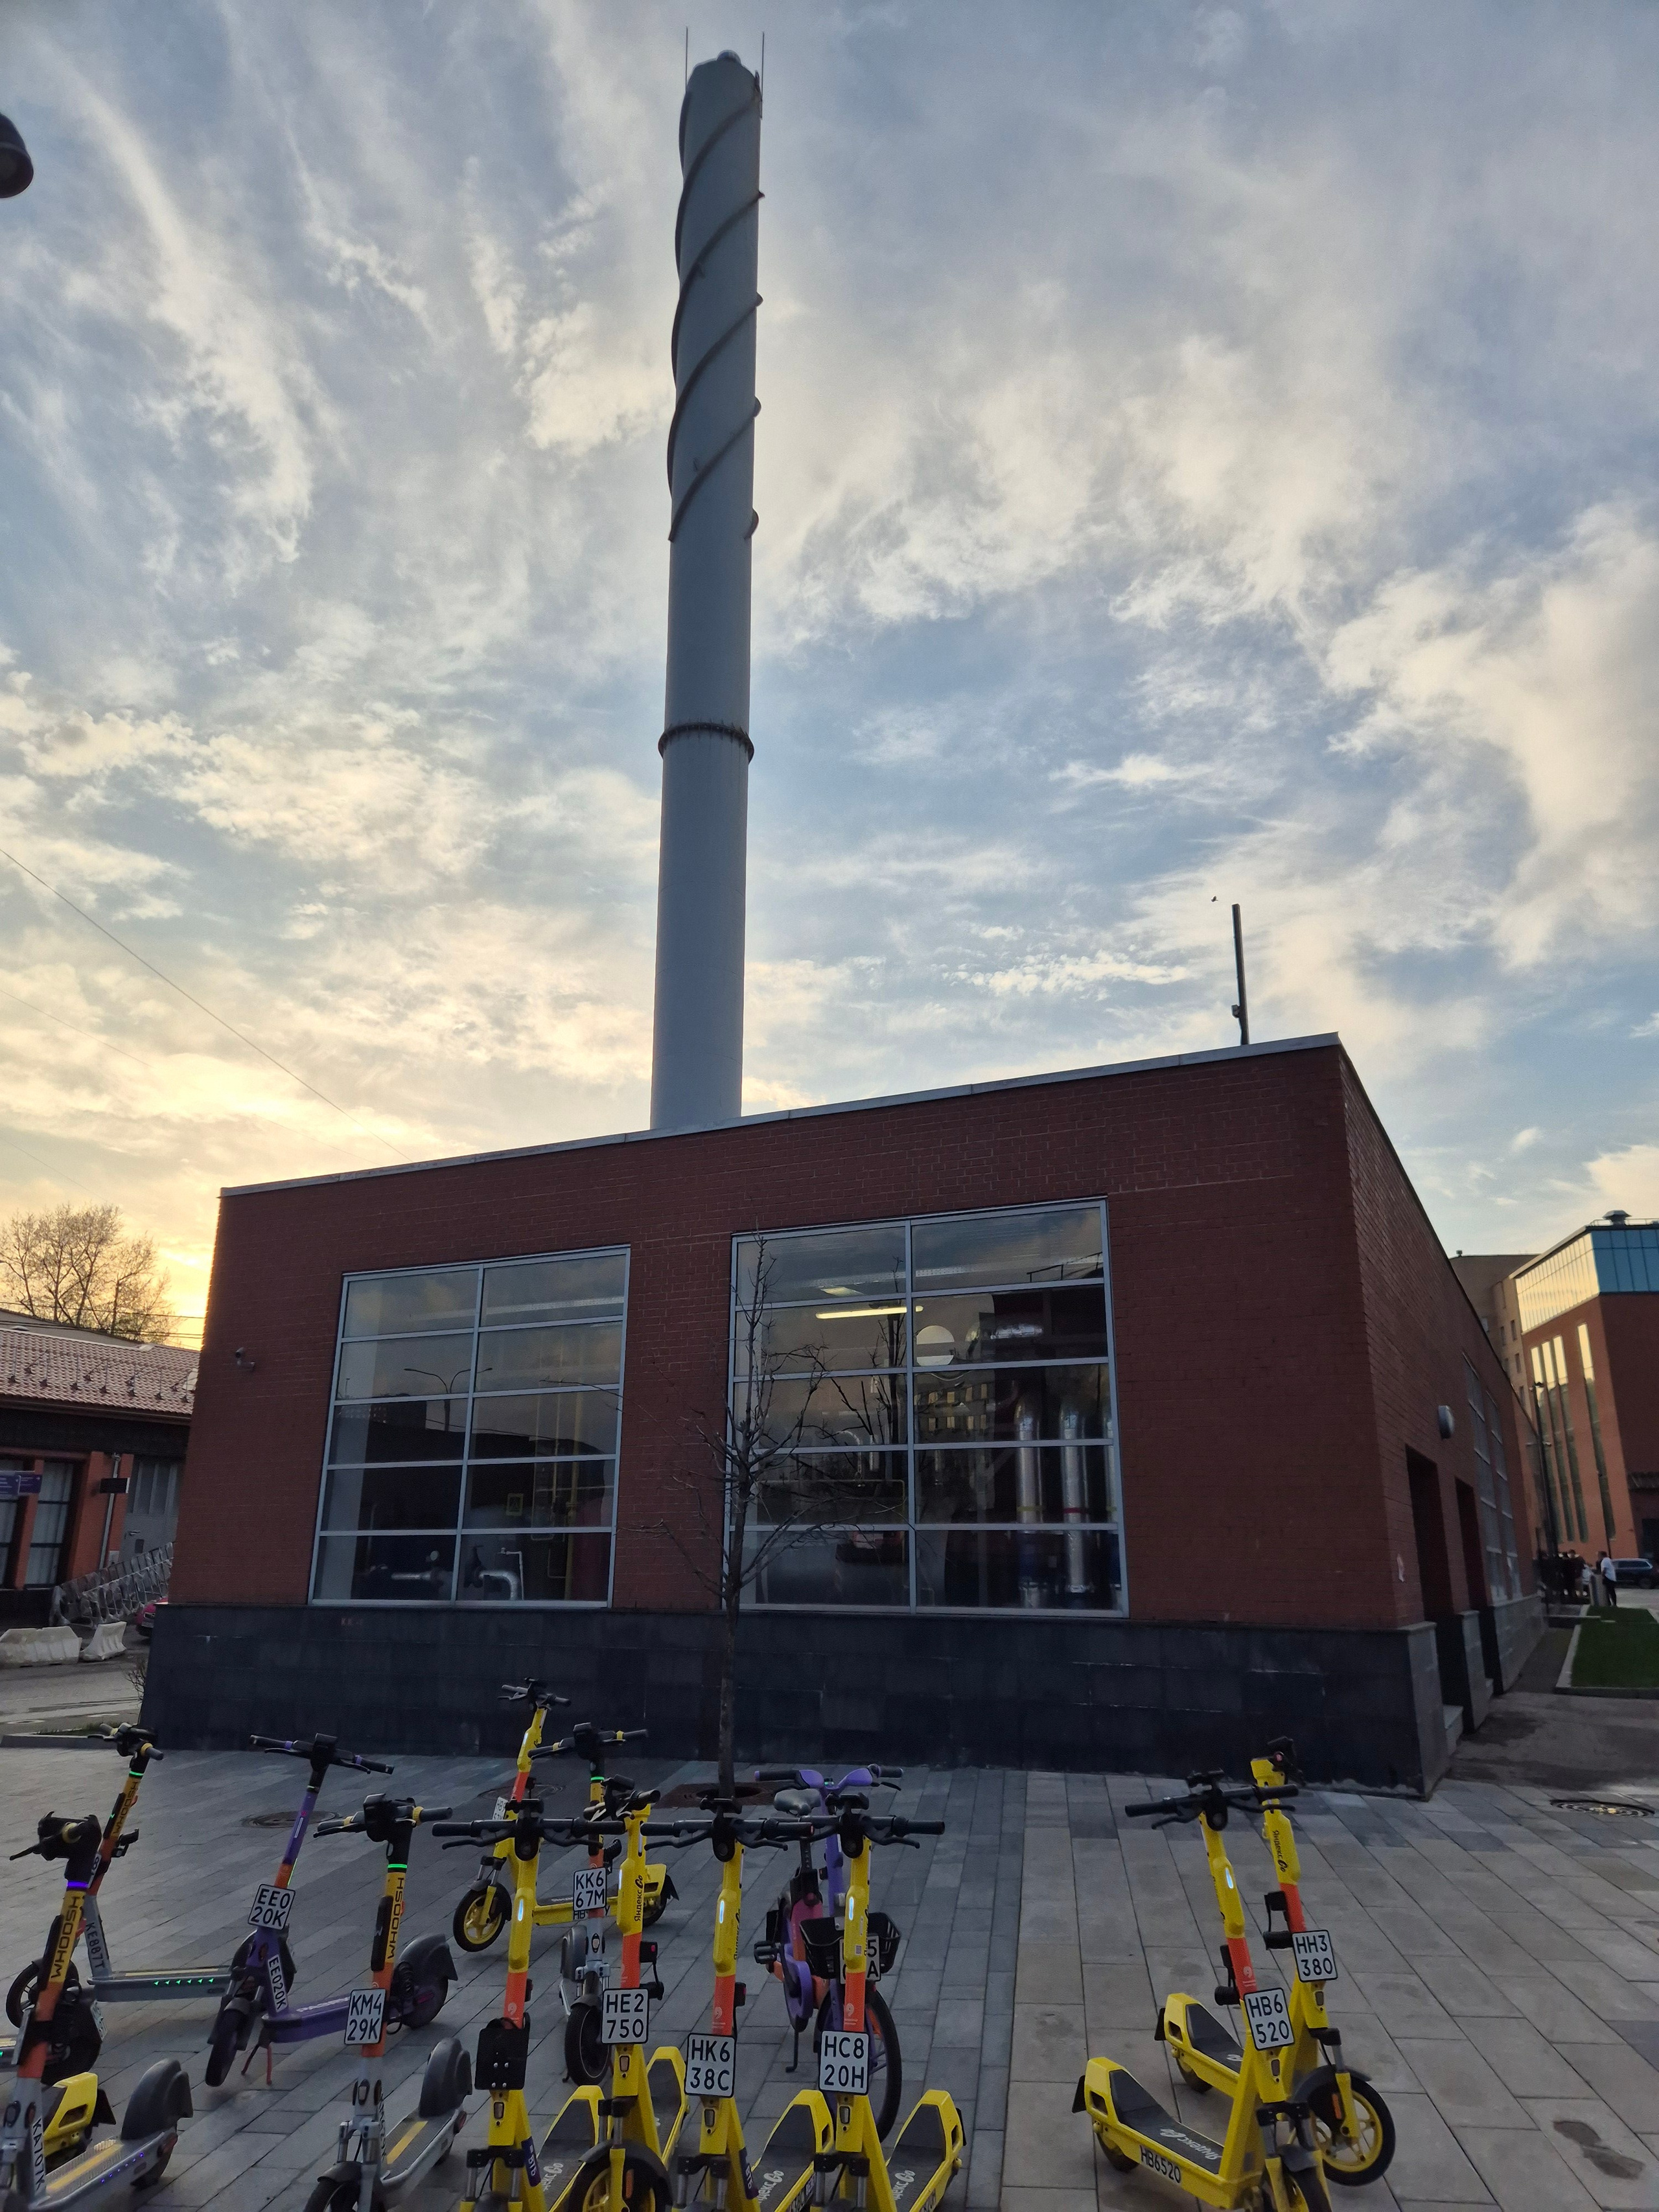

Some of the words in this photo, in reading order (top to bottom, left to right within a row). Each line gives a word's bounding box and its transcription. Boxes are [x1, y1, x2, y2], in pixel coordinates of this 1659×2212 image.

[113, 1782, 138, 1834] WHOOSH
[1273, 1830, 1282, 1859] Яндекс
[1277, 1859, 1288, 1872] Go
[575, 1868, 604, 1891] KK6
[634, 1875, 644, 1889] Go
[257, 1889, 290, 1909] EE0
[575, 1889, 605, 1908] 67M
[634, 1889, 642, 1922] Яндекс
[251, 1906, 286, 1928] 20K
[388, 1877, 404, 1959] WHOOSH
[51, 1895, 82, 1979] WHOOSH
[86, 1922, 105, 1968] KE887T
[1296, 1935, 1328, 1954] HH3
[1301, 1957, 1333, 1977] 380
[268, 1956, 286, 2010] EE020K
[350, 1993, 382, 2016] KM4
[606, 1993, 644, 2014] HE2
[1248, 1994, 1283, 2018] HB6
[347, 2018, 378, 2042] 29K
[607, 2018, 644, 2039] 750
[1256, 2020, 1290, 2044] 520
[691, 2039, 730, 2062] HK6
[824, 2035, 864, 2059] HC8
[690, 2067, 730, 2091] 38C
[824, 2064, 864, 2088] 20H
[32, 2117, 45, 2191] KA707K
[528, 2154, 537, 2176] ВТБ
[1139, 2145, 1181, 2184] HB6520
[543, 2163, 564, 2174] Go
[763, 2170, 785, 2183] Go
[894, 2170, 916, 2183] Go
